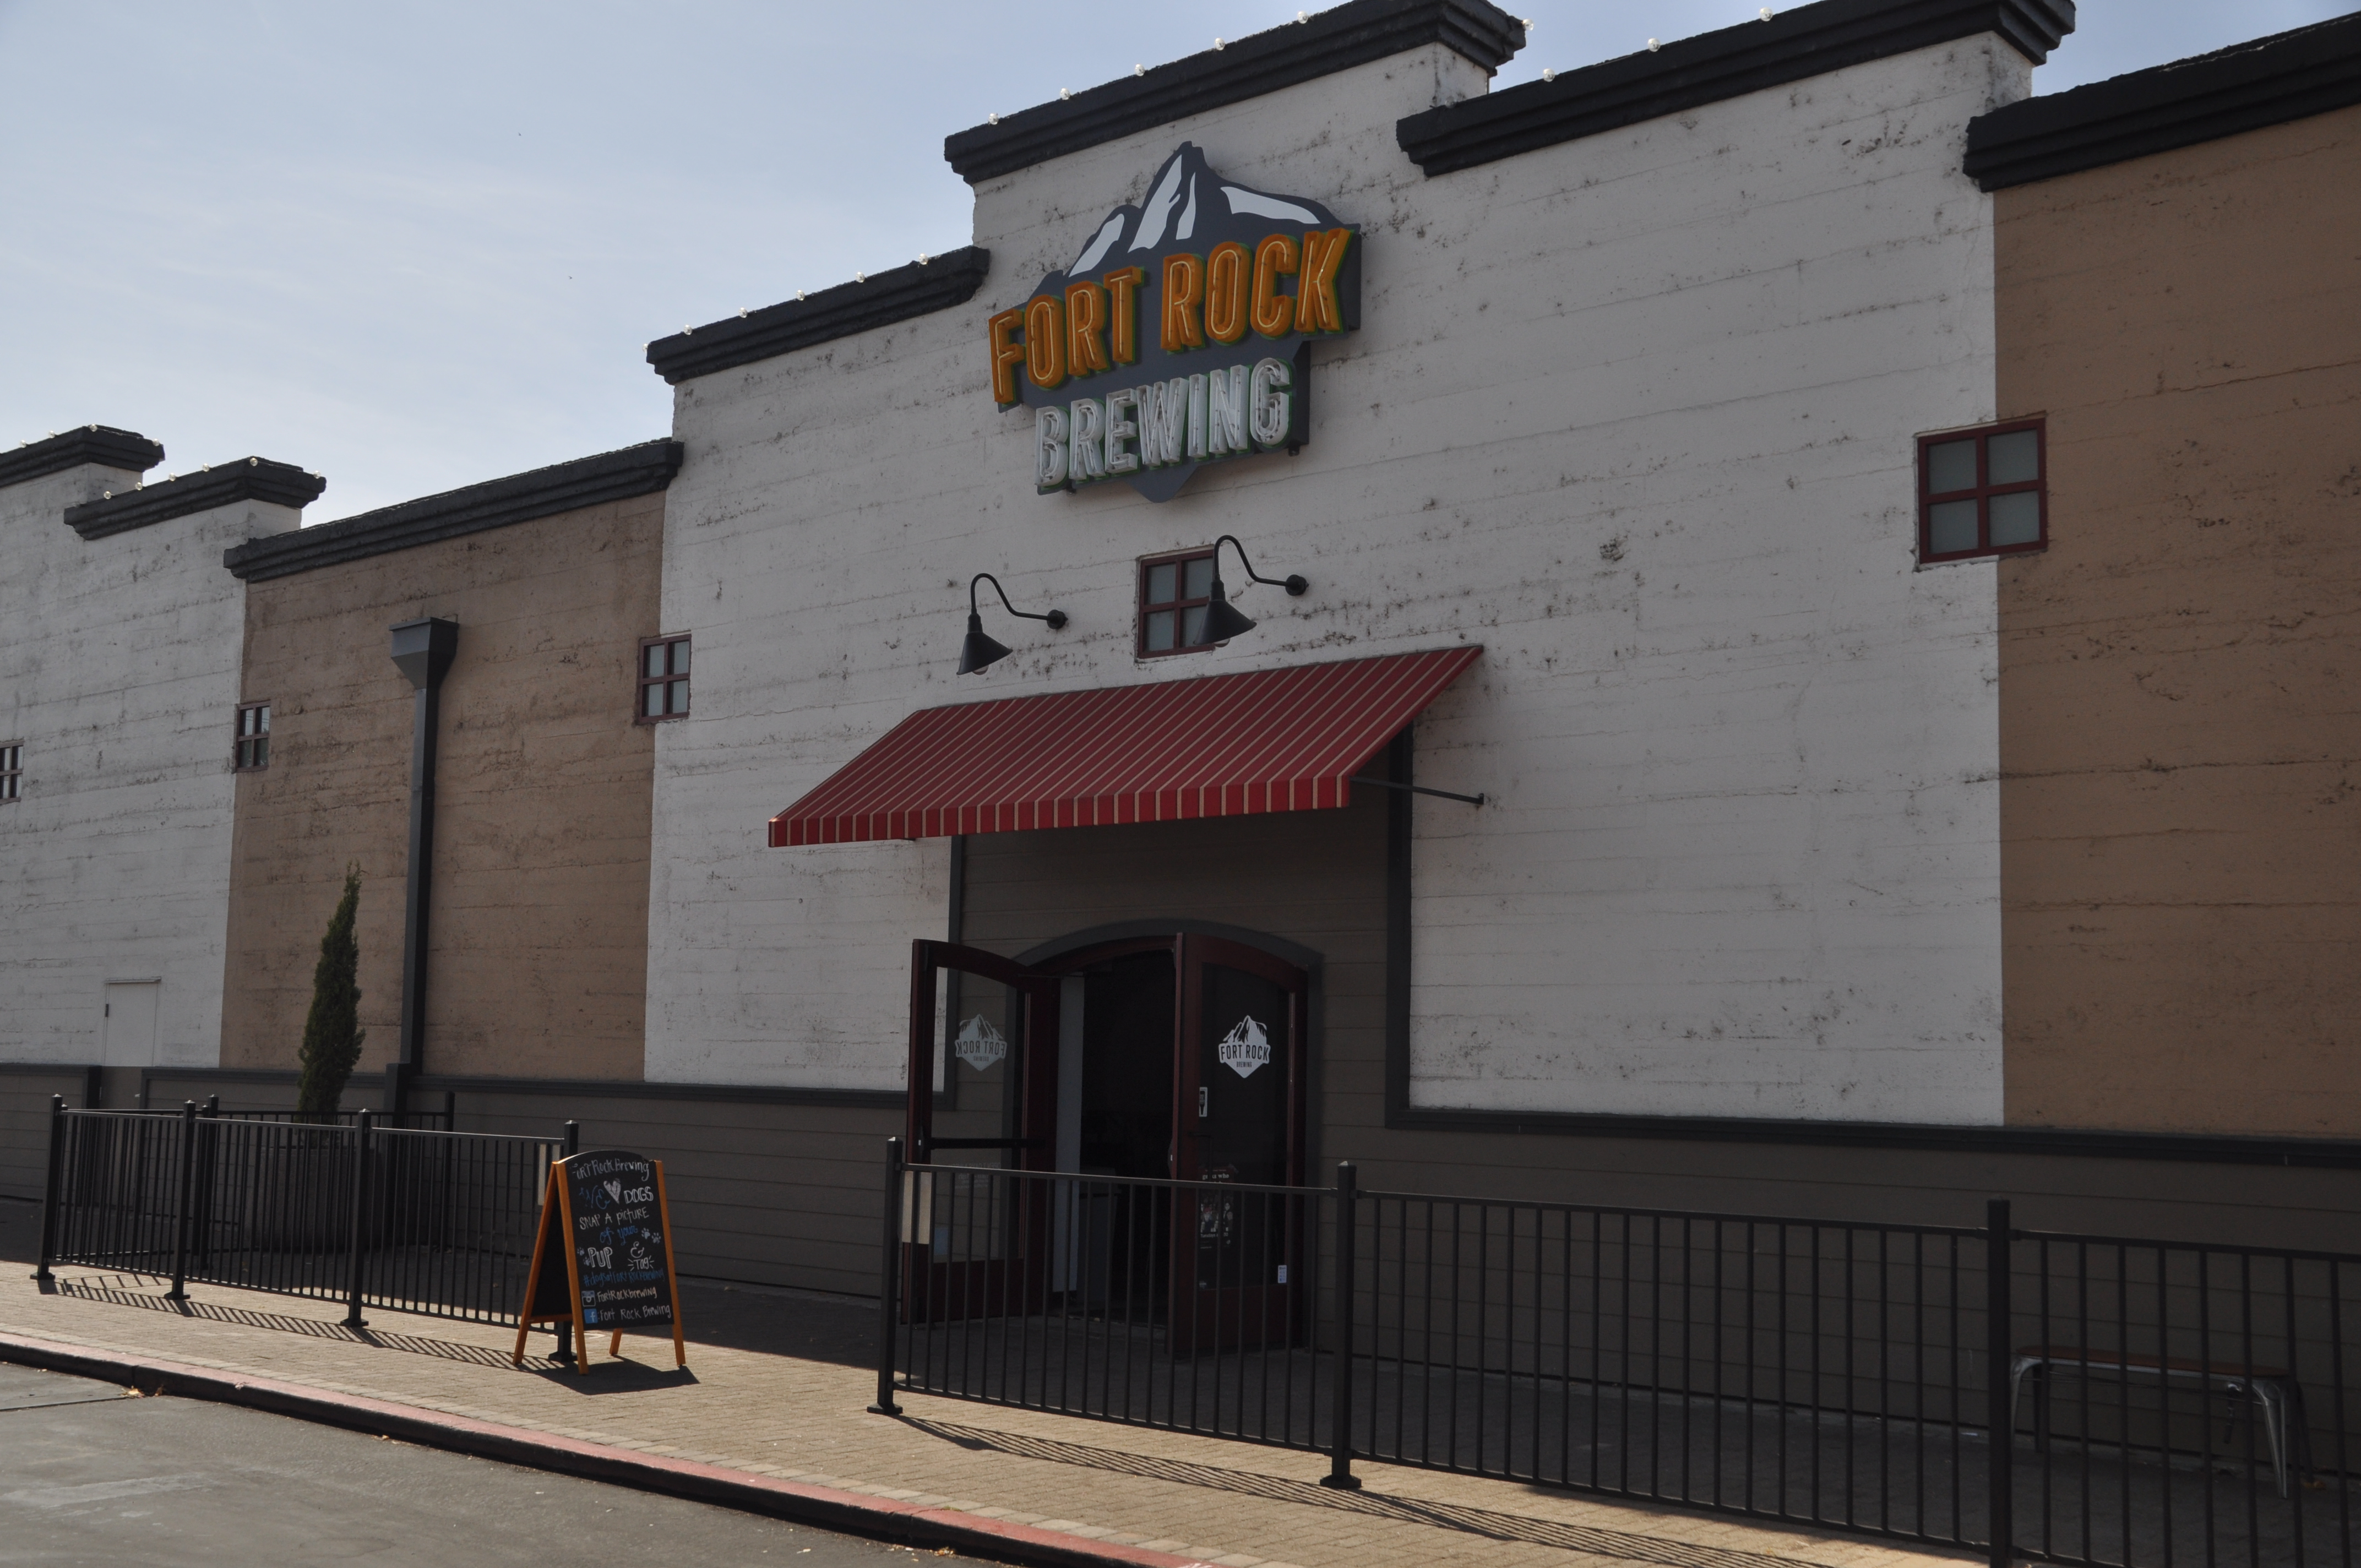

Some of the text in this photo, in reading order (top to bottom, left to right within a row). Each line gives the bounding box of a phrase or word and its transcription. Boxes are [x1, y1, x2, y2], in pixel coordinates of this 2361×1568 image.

[989, 228, 1352, 404] FORT ROCK
[1035, 358, 1291, 487] BREWING
[1220, 1044, 1269, 1061] FORT ROCK
[614, 1158, 650, 1182] Brewing
[623, 1186, 654, 1204] DOGS
[579, 1213, 601, 1230] SNAP
[605, 1212, 613, 1224] A
[600, 1227, 614, 1245] of
[630, 1241, 645, 1259] &
[642, 1304, 672, 1319] Brewing
